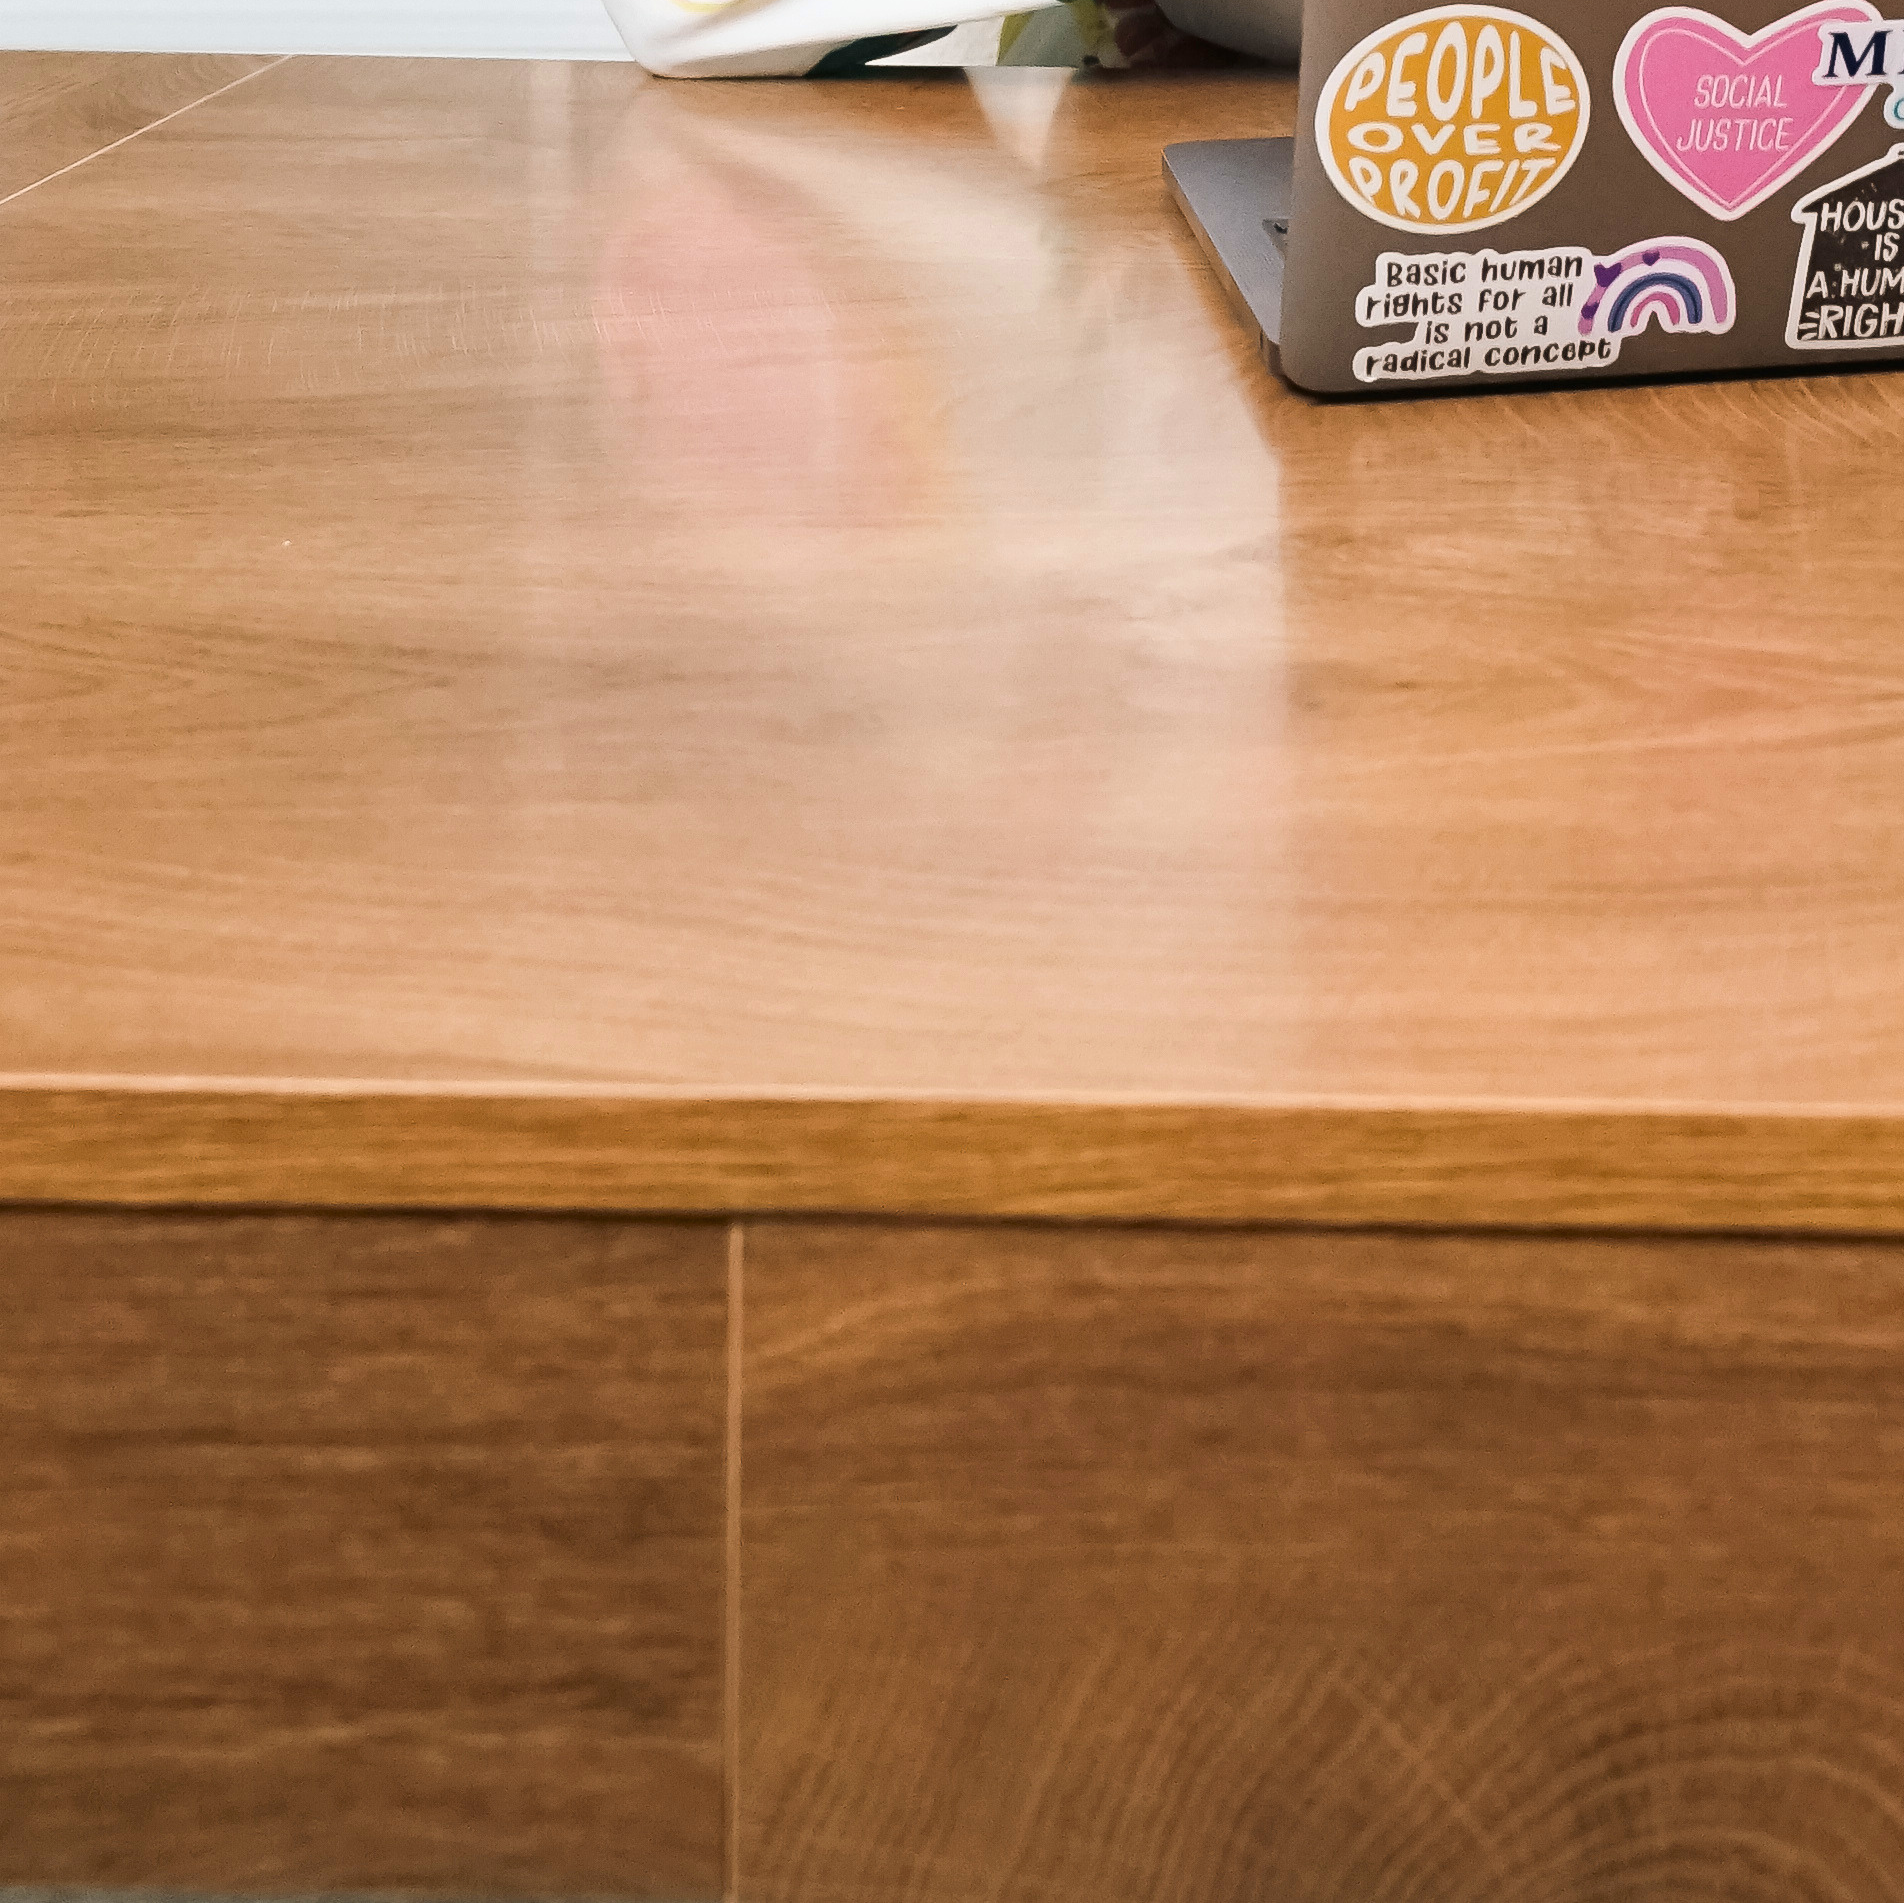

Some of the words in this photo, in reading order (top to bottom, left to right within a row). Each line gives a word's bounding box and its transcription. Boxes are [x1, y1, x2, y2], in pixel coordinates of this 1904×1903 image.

[1344, 21, 1576, 121] PEOPLE
[1694, 75, 1787, 108] SOCIAL
[1347, 122, 1562, 155] OVER
[1676, 117, 1794, 152] JUSTICE
[1349, 156, 1556, 220] PROFIT
[1874, 232, 1901, 262] IS
[1387, 260, 1467, 287] Basic
[1481, 255, 1583, 284] human
[1806, 270, 1829, 299] A
[1365, 292, 1463, 321] rights
[1541, 283, 1574, 309] all
[1425, 321, 1449, 345] is
[1465, 316, 1521, 343] not
[1533, 316, 1549, 335] a
[1366, 346, 1471, 377] radical
[1484, 337, 1613, 368] concept
